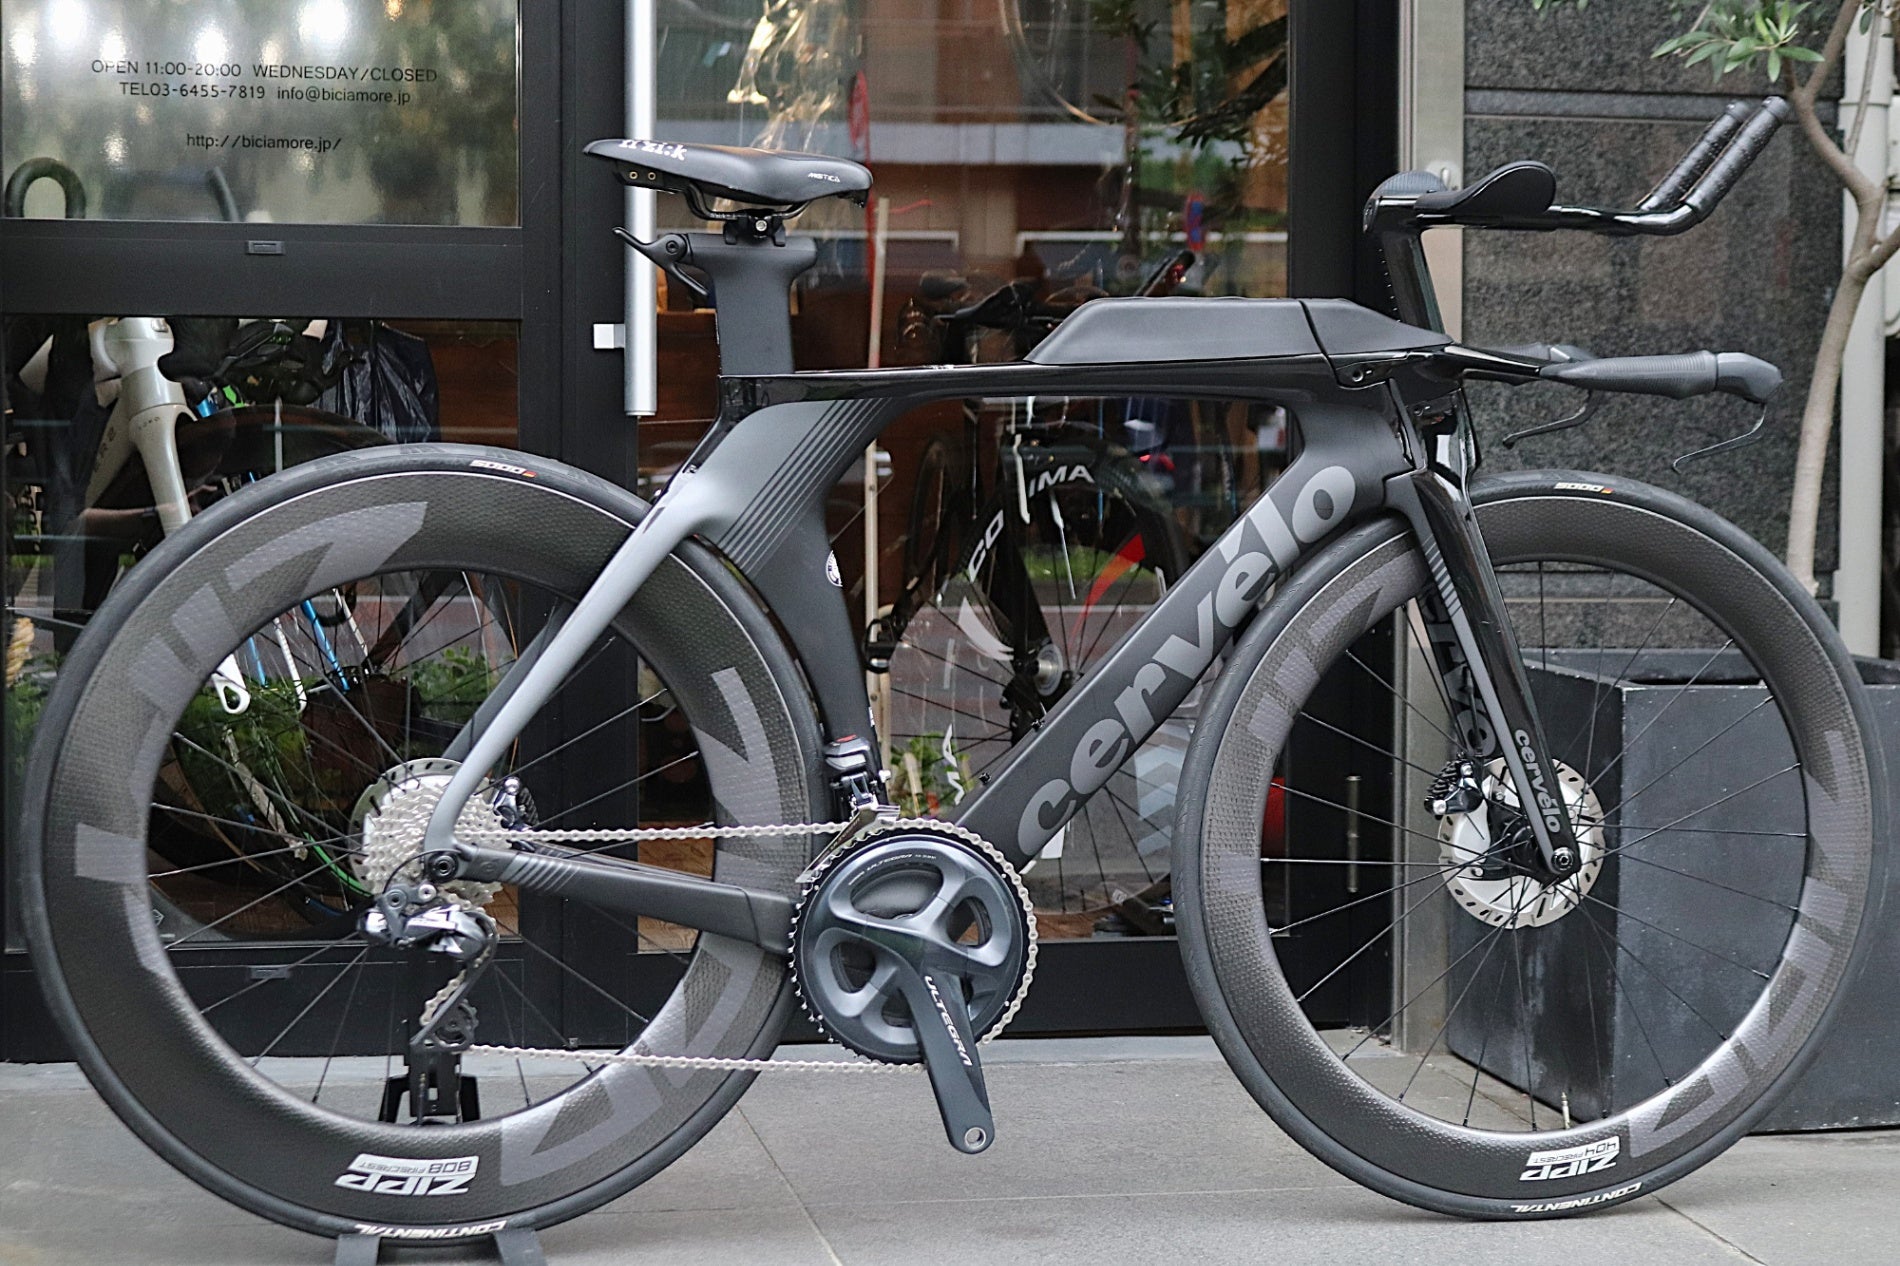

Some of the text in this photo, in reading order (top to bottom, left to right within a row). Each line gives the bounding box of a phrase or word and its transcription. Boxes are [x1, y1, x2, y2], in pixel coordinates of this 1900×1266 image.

[92, 60, 438, 83] OPEN 11:00-20:00 WEDNESDAY/CLOSED
[120, 82, 411, 106] TEL03-6455-7819 info@biciamore.jp
[187, 133, 342, 152] http://biciamore.jp/
[470, 460, 527, 475] 5000
[1554, 482, 1605, 493] 5000
[1018, 466, 1356, 855] cervélo
[1514, 729, 1561, 834] cervélo
[924, 975, 973, 1067] ULTEGRA
[1533, 1143, 1617, 1164] 404 FIRECREST
[359, 1160, 473, 1175] 808 FIRECREST
[1519, 1151, 1620, 1181] ZIPP
[334, 1171, 477, 1197] ZIPP
[1510, 1181, 1643, 1213] CONTINENTAL
[354, 1219, 508, 1240] CONTINENTAL
